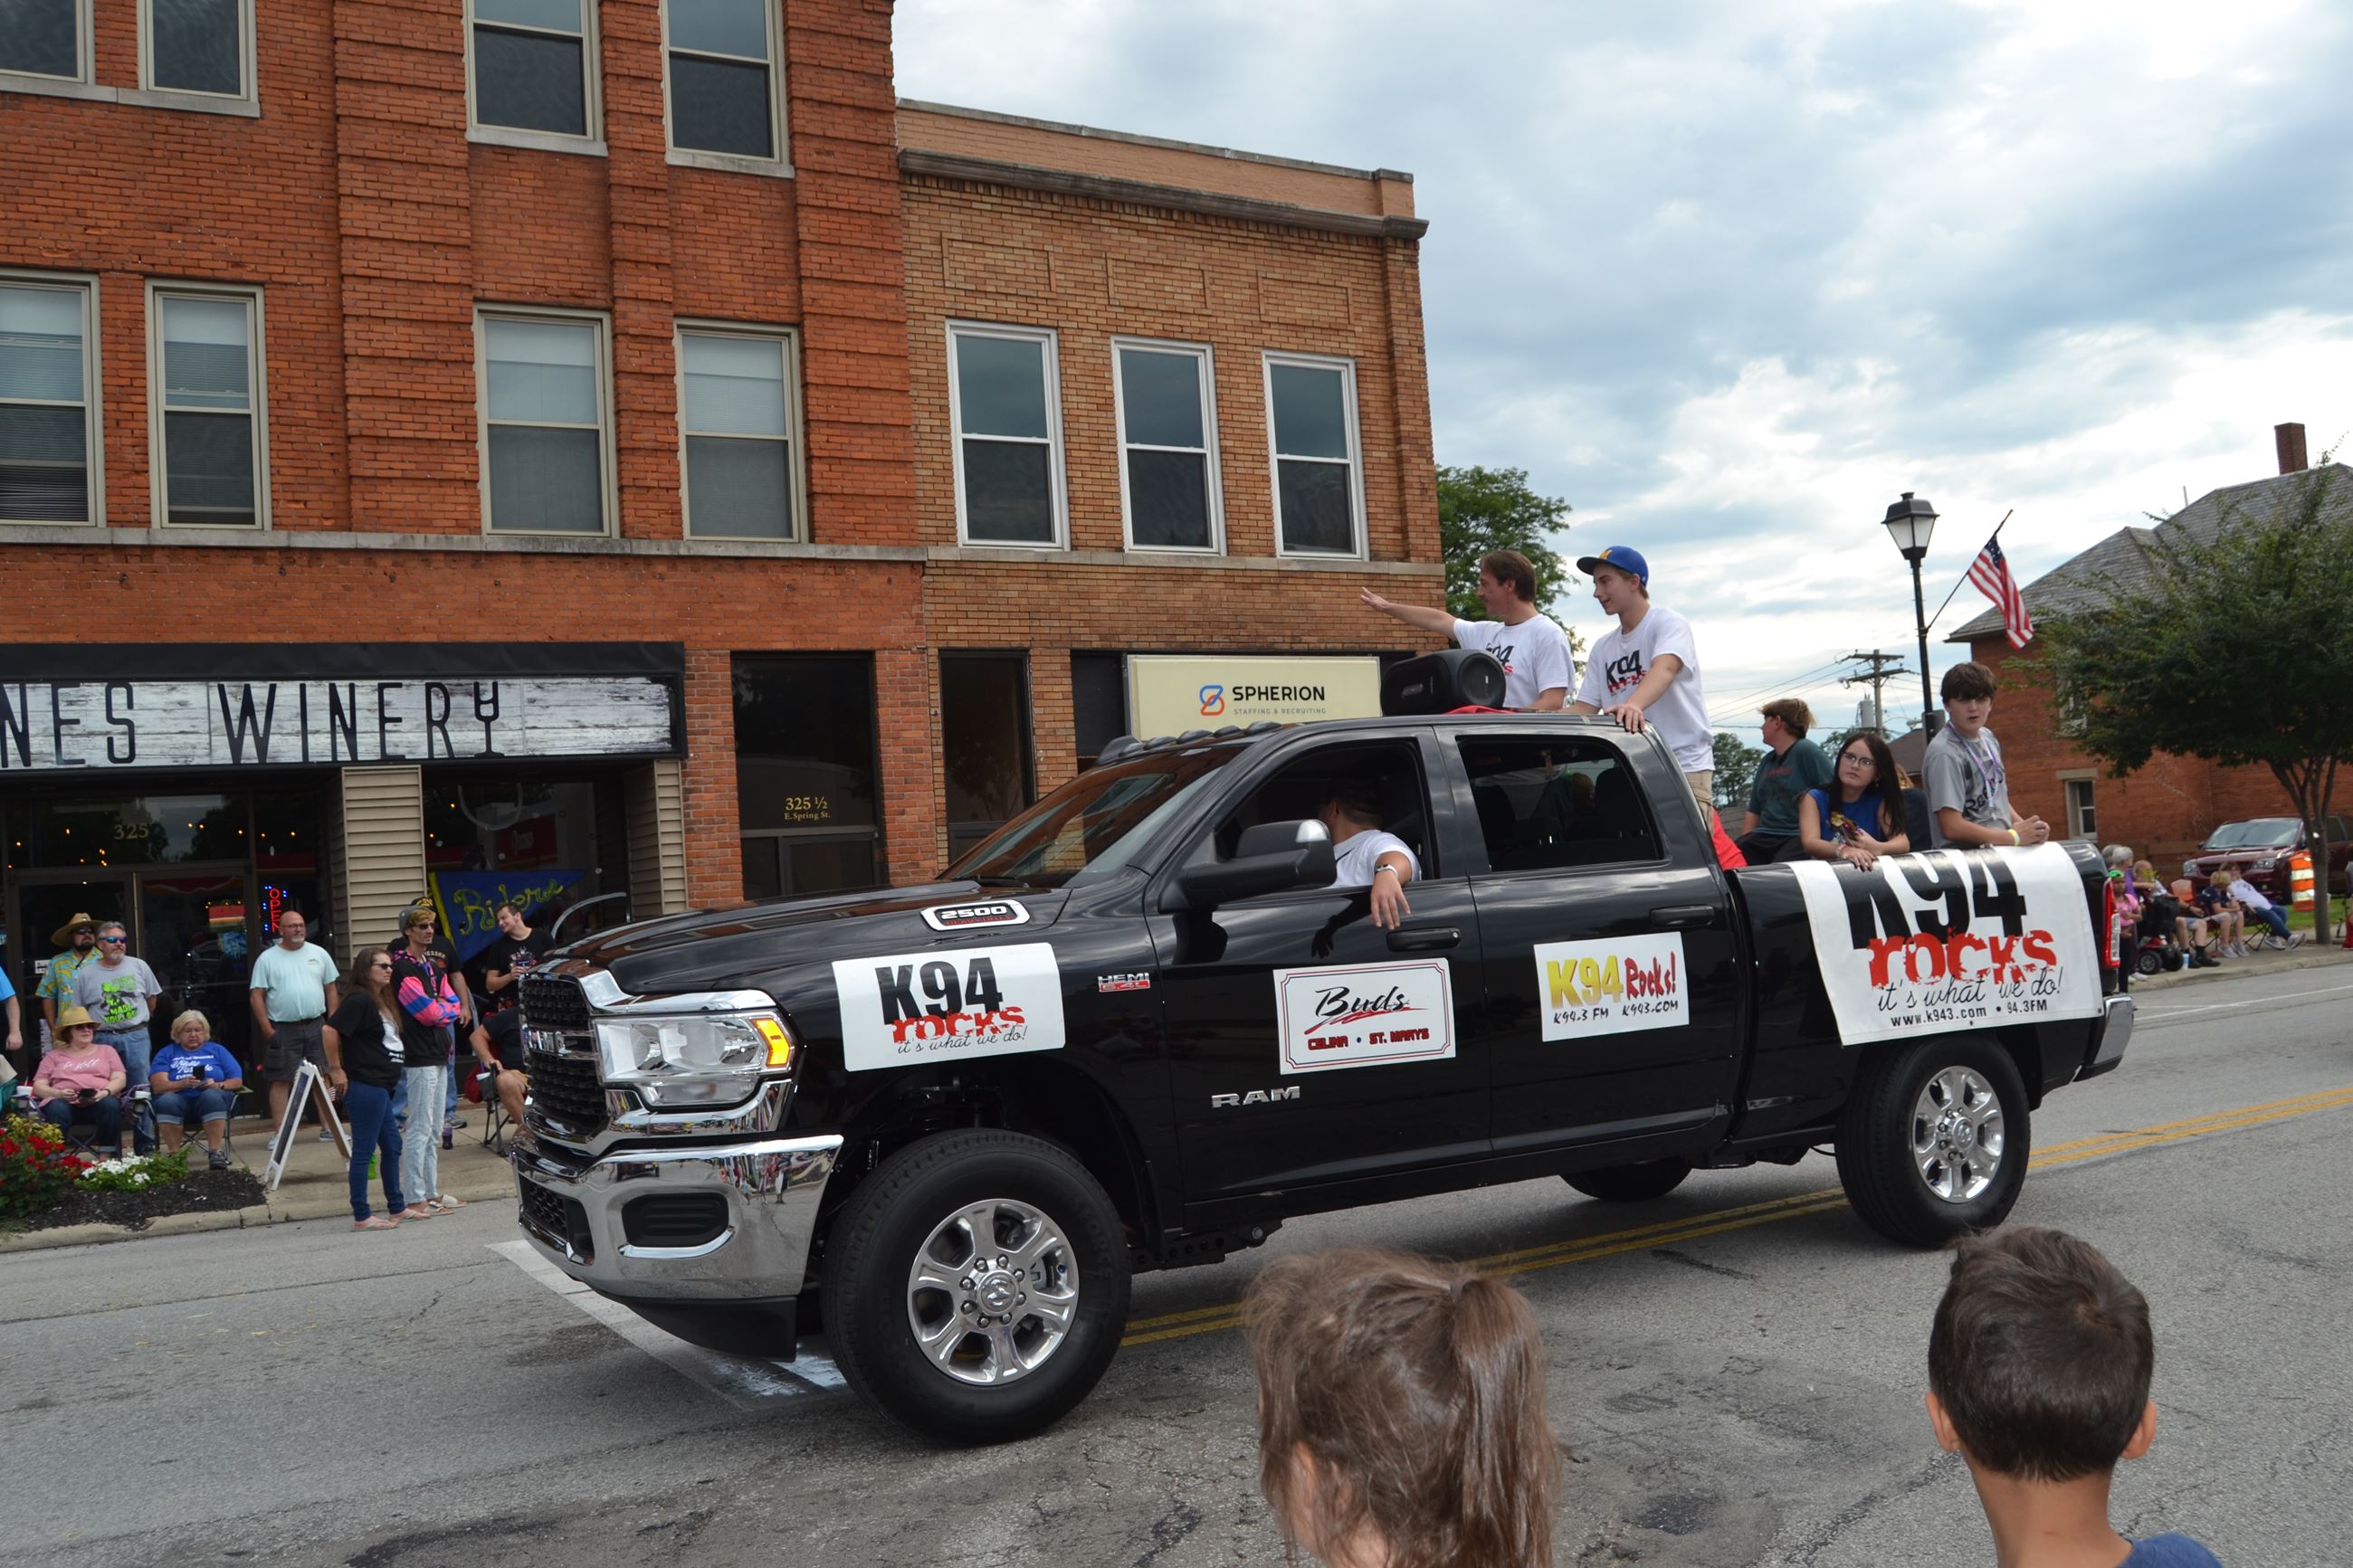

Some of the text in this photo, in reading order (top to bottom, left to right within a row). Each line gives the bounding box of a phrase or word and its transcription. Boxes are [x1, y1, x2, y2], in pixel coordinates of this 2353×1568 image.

[1233, 686, 1325, 701] SPHERION
[1, 681, 504, 767] NES WINERY
[786, 797, 811, 811] 325
[793, 812, 819, 822] Spring
[820, 811, 831, 819] St.
[114, 824, 149, 840] 325
[941, 906, 1007, 919] 2500
[1866, 929, 2057, 989] rocks
[875, 956, 1004, 1025] K94
[1098, 972, 1150, 984] HEMI
[1547, 951, 1676, 1009] K94 Rocks!
[1878, 966, 2065, 1012] it's what we do!
[1314, 985, 1405, 1018] Buds
[1553, 999, 1679, 1024] K94.3 FM K943.COM
[1891, 999, 2048, 1028] www.k943.com 94.3FM
[891, 1005, 1026, 1043] rocks
[898, 1025, 1028, 1054] it's what we do!
[1308, 1028, 1430, 1050] CELINA ST. MARYS
[1212, 1086, 1300, 1108] RAM
